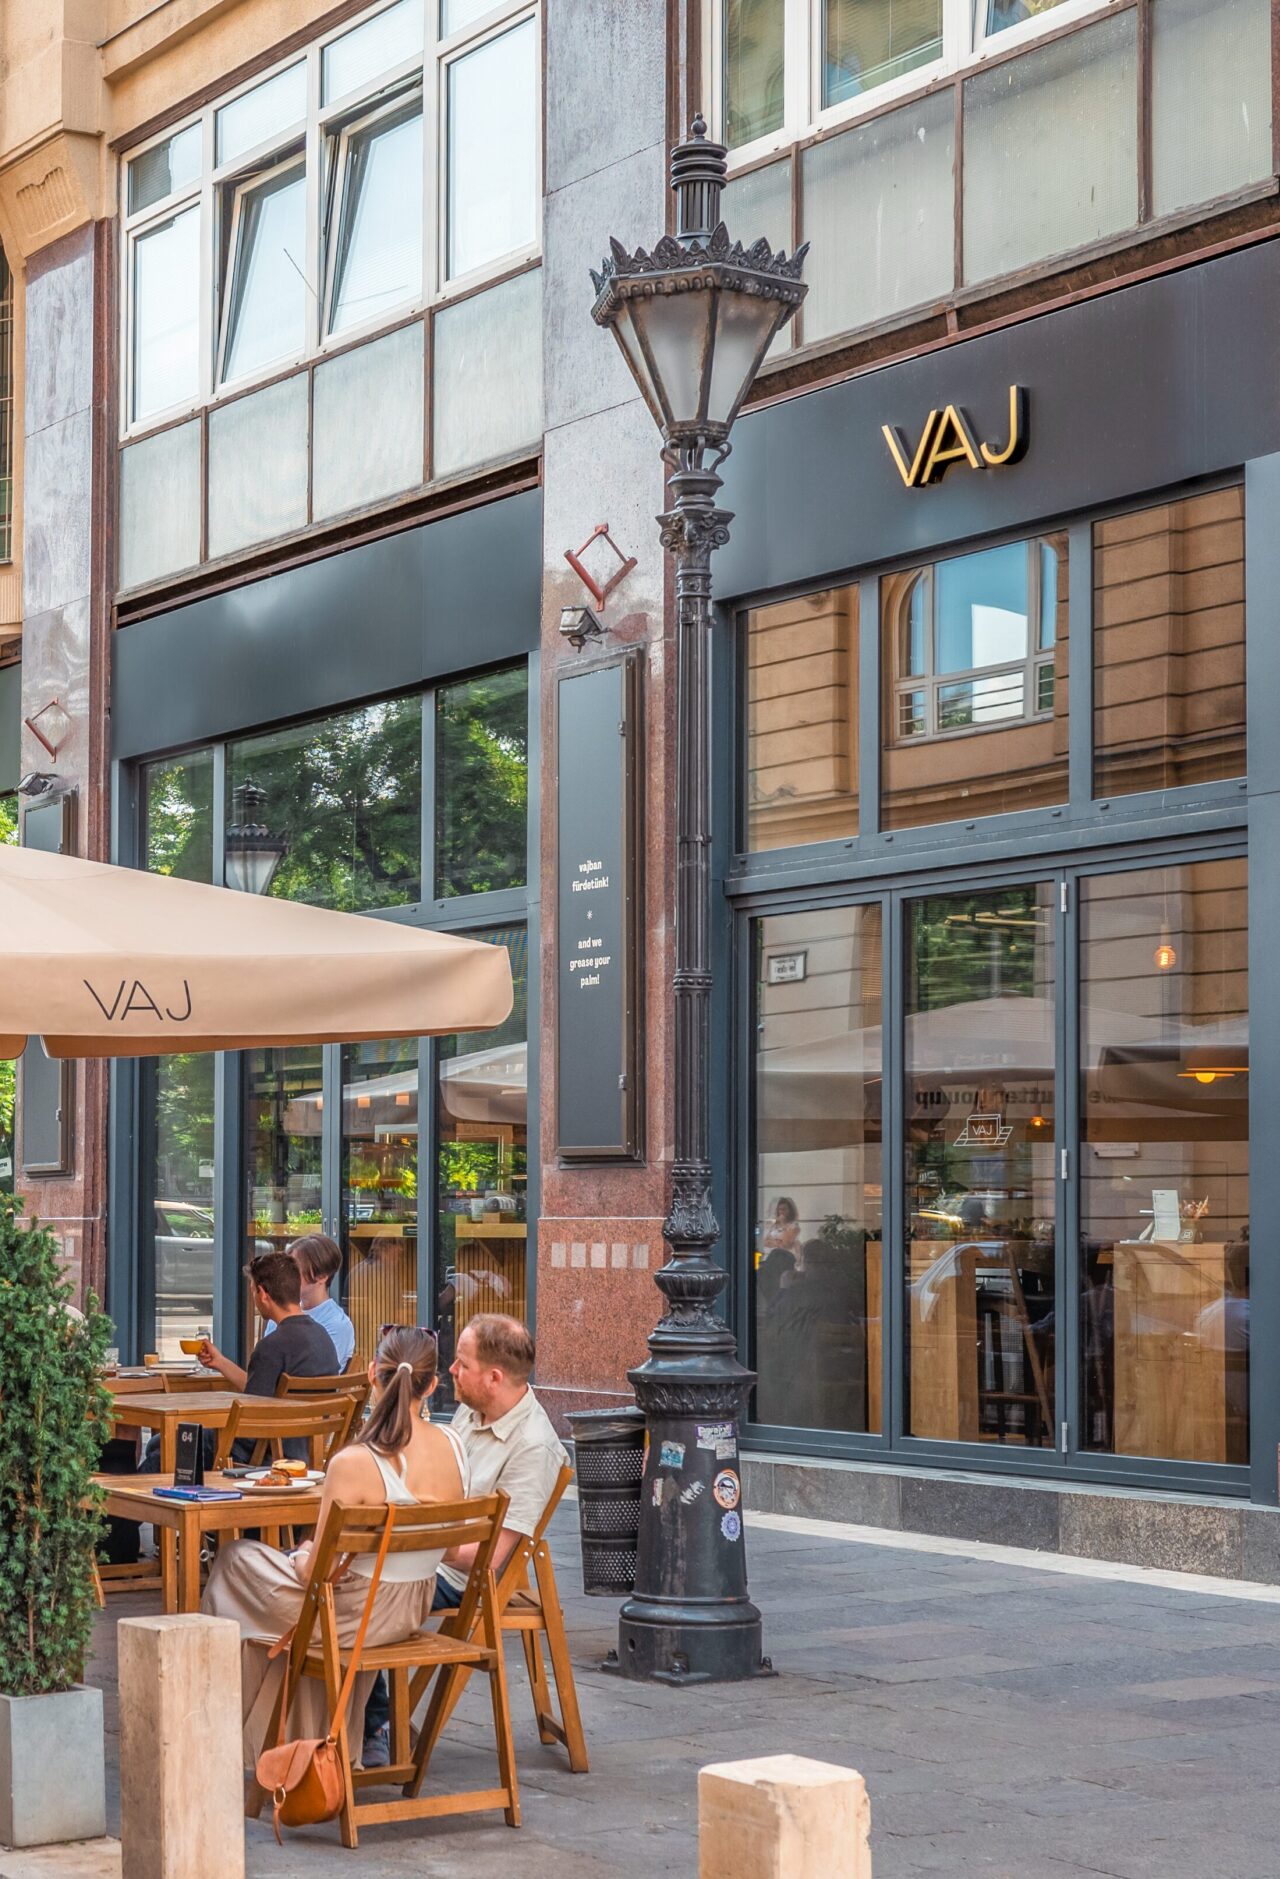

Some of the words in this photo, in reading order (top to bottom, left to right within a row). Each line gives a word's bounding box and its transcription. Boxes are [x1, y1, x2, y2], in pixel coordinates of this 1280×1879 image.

[882, 384, 1024, 487] VAJ
[578, 860, 602, 874] vajban
[572, 876, 609, 892] fürdetünk!
[578, 937, 591, 949] and
[592, 938, 602, 948] we
[569, 958, 594, 972] grease
[594, 956, 611, 969] your
[580, 974, 600, 989] palm!
[83, 979, 192, 1021] VAJ
[971, 1124, 993, 1137] VAJ
[181, 1431, 194, 1443] 64
